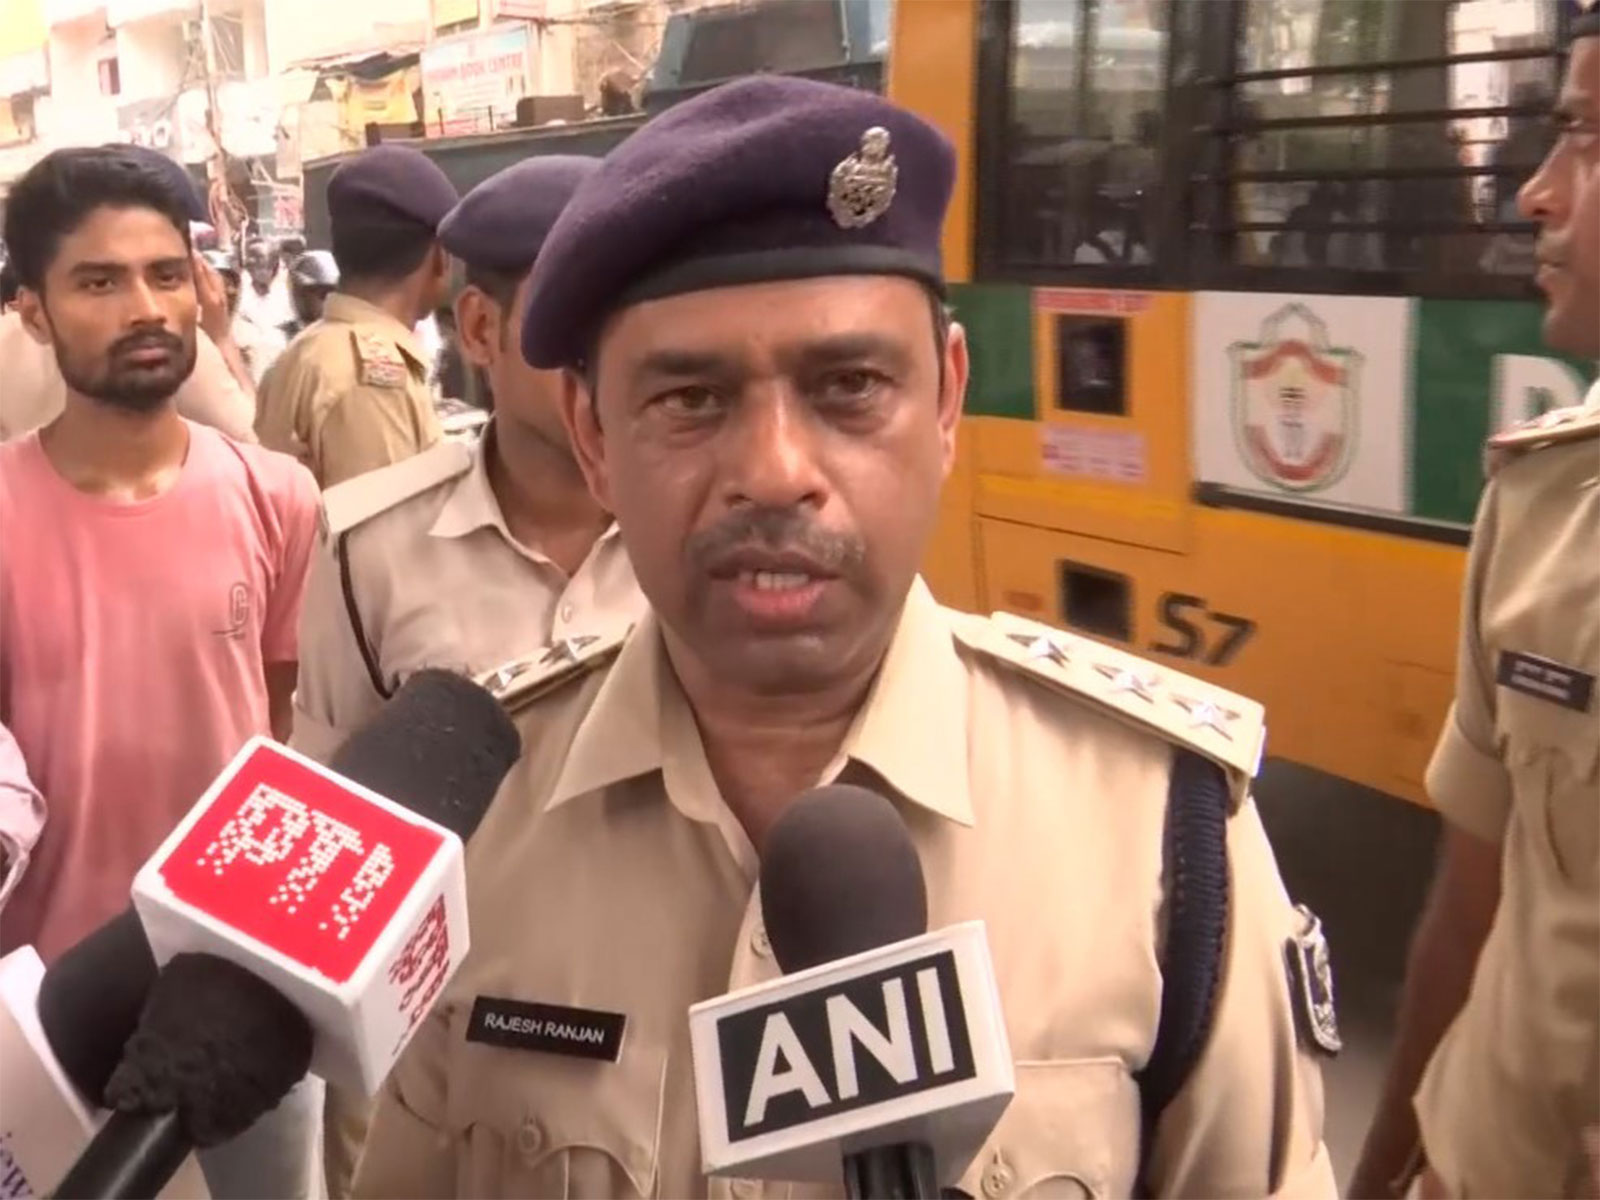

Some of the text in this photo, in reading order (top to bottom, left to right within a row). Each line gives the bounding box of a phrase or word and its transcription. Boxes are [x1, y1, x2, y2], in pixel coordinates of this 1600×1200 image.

[1151, 591, 1257, 666] S7
[484, 1012, 605, 1043] RAJESH RANJAN
[743, 966, 955, 1127] ANI
